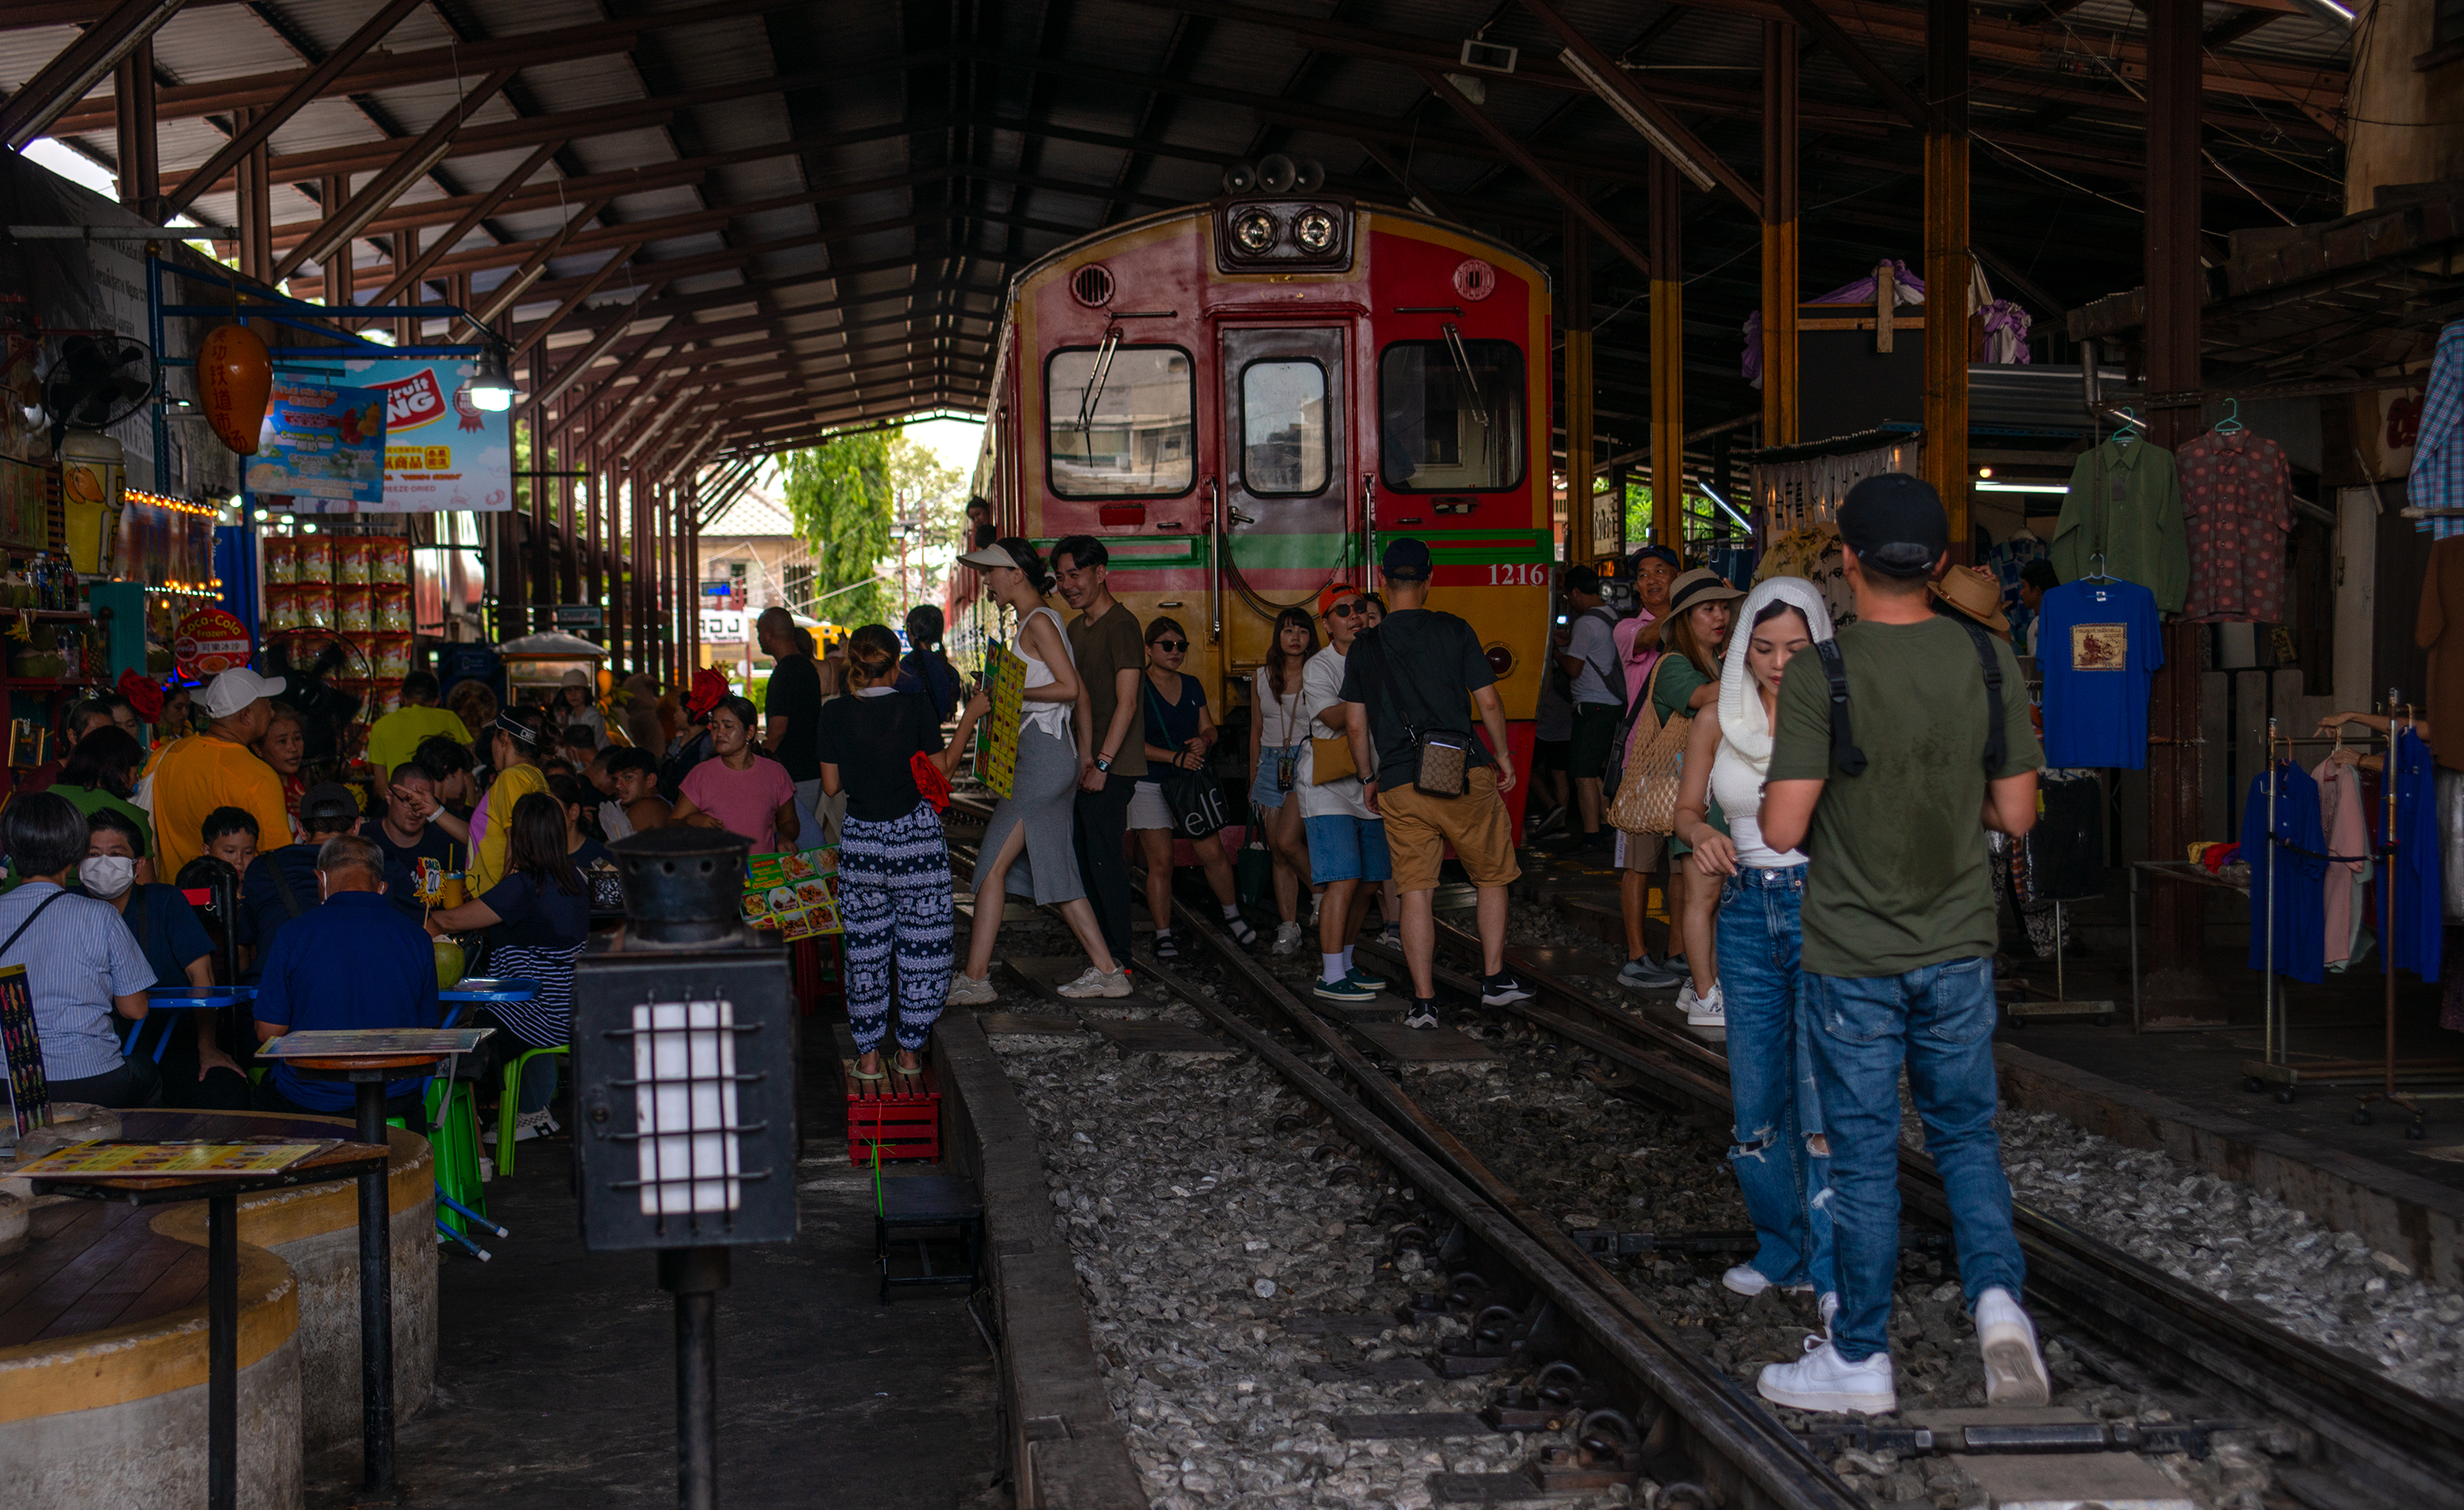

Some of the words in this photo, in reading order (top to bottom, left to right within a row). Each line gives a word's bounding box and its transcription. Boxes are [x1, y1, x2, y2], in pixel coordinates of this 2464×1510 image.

[387, 390, 436, 424] NG
[1488, 563, 1544, 587] 1216
[180, 615, 241, 637] Coca-Cola
[197, 629, 227, 638] Frozen
[520, 729, 536, 742] CHR
[1185, 788, 1228, 836] e.l.f.
